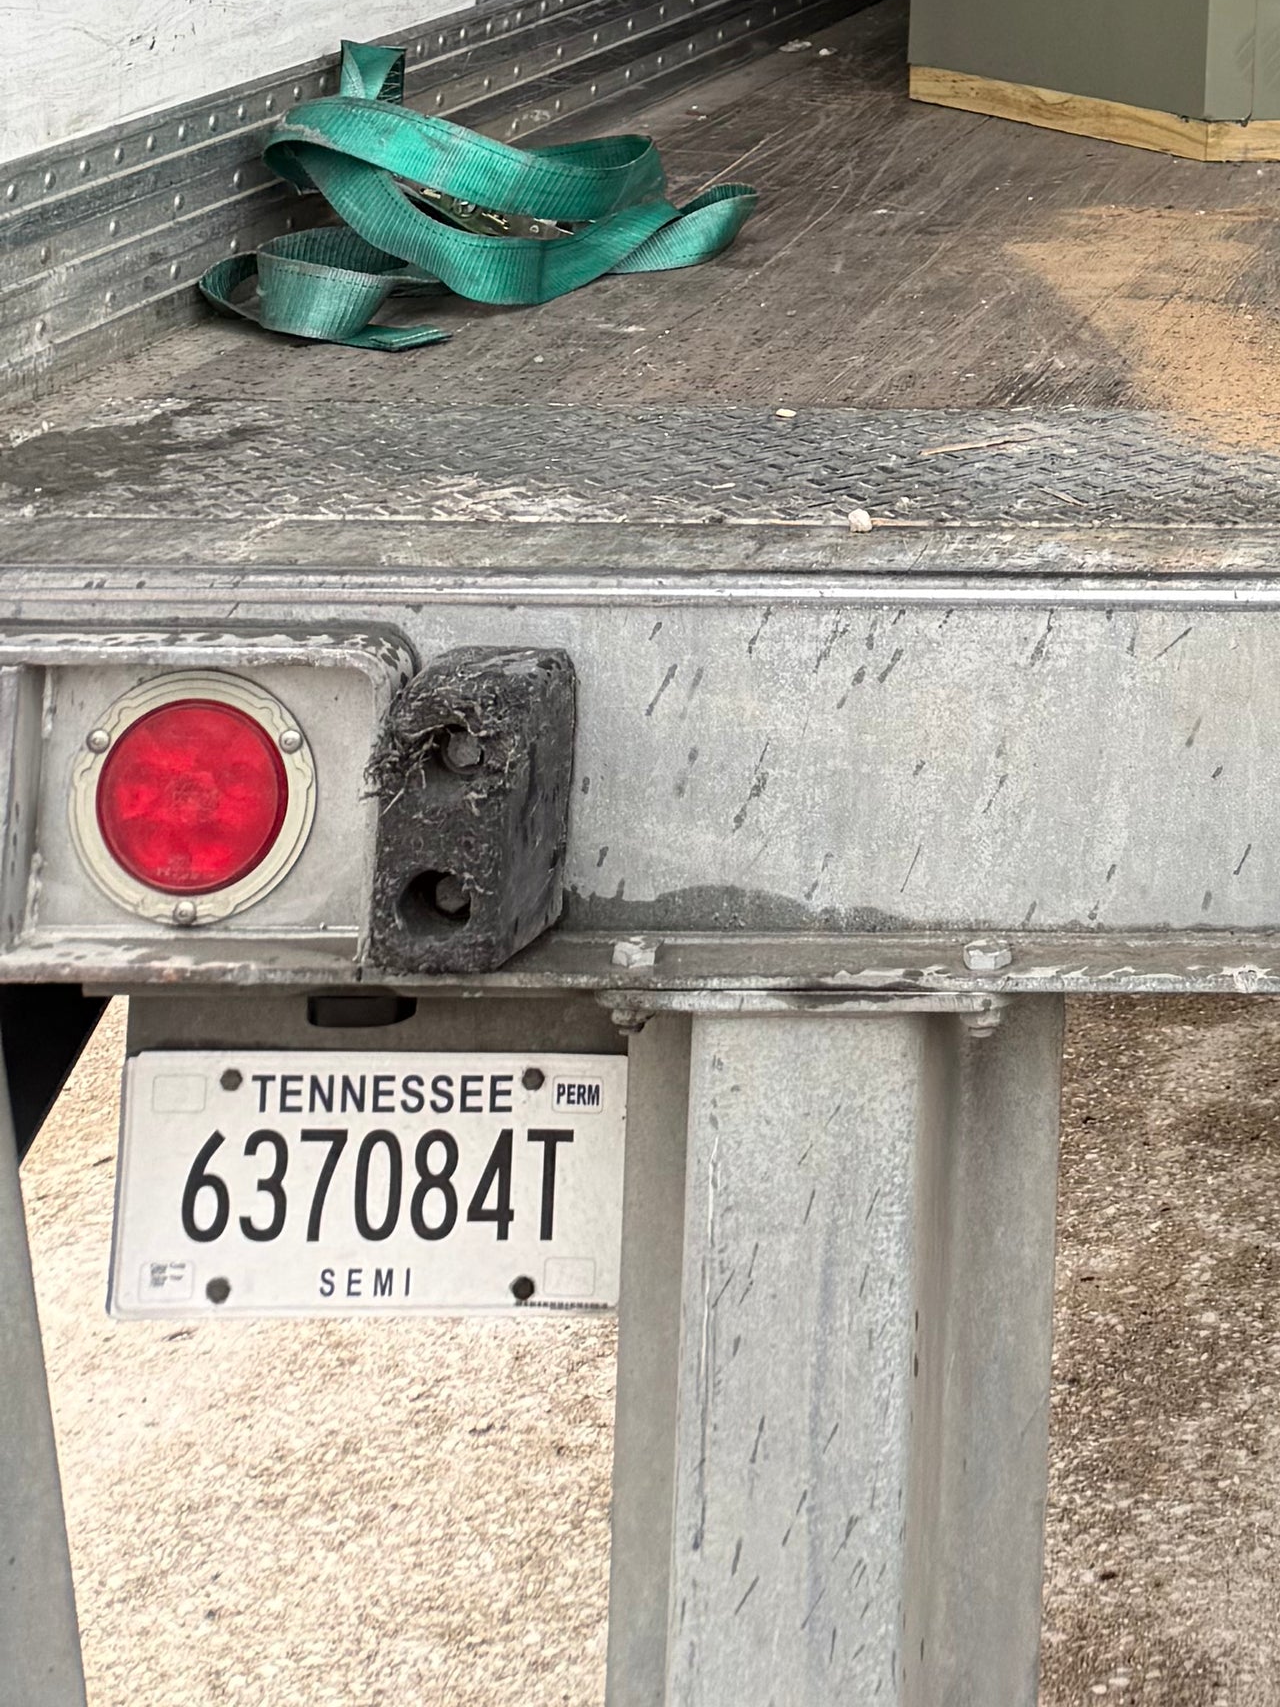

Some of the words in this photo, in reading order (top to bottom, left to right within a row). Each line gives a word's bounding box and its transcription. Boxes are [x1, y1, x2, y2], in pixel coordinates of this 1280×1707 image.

[252, 1073, 514, 1114] TENNESSEE
[556, 1082, 600, 1106] PERM
[180, 1128, 575, 1243] 637084T
[319, 1266, 412, 1298] SEMI
